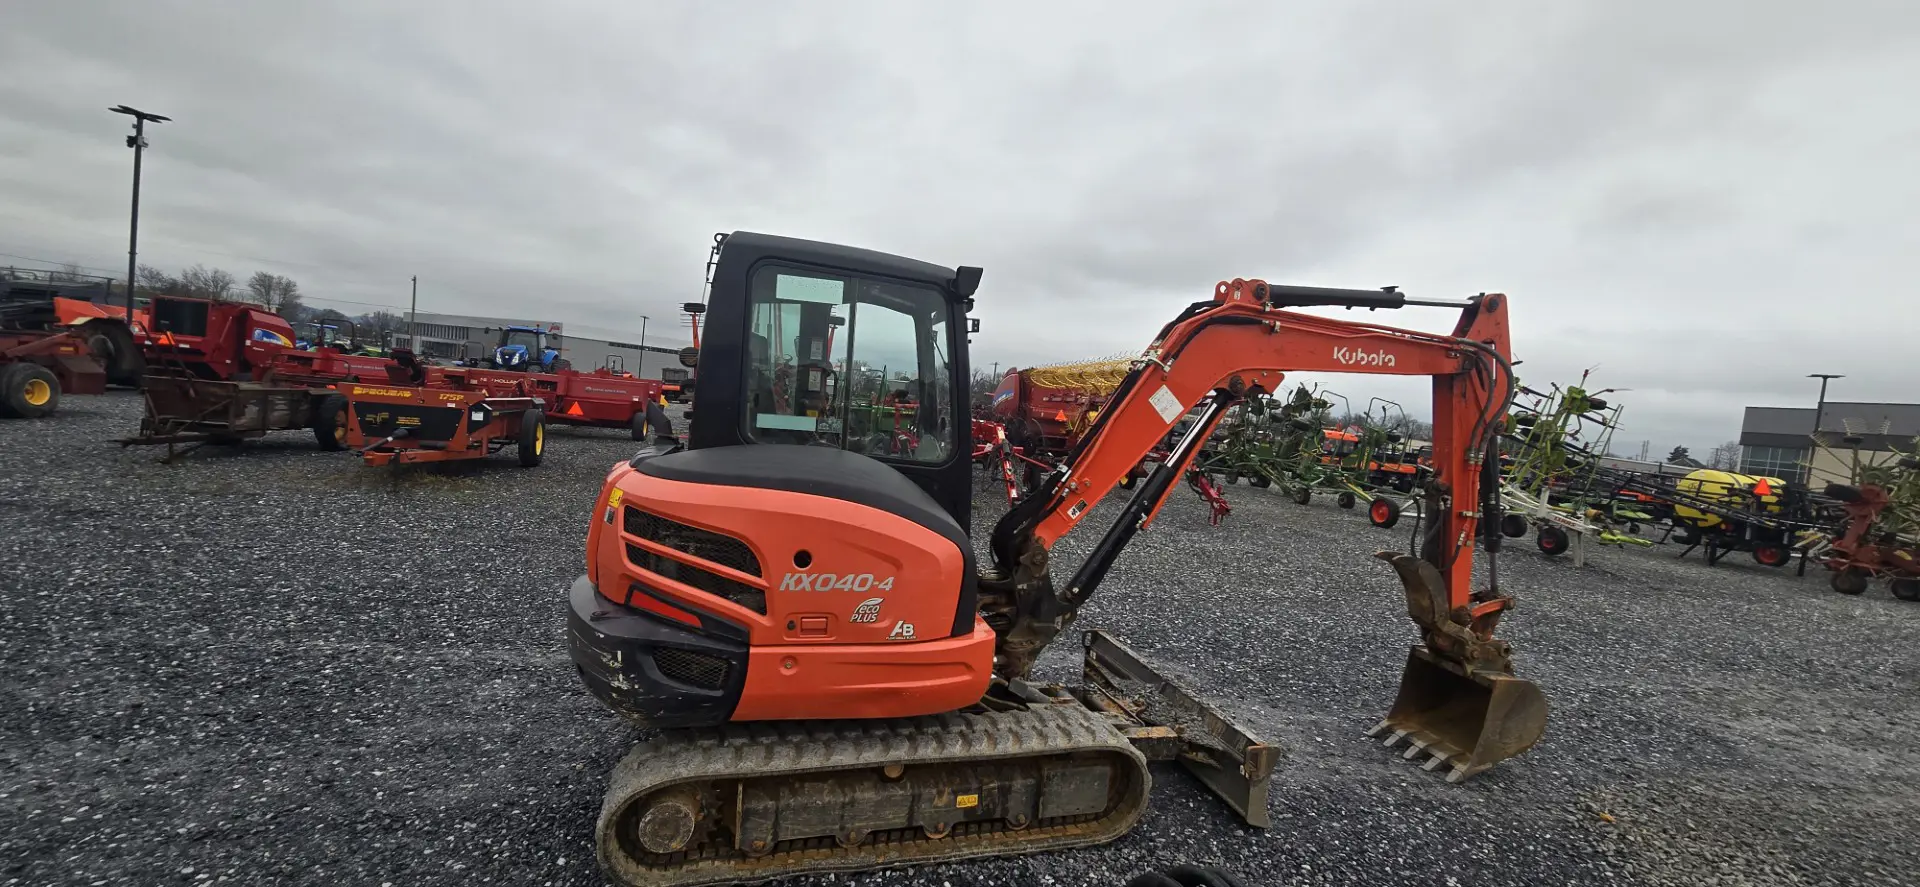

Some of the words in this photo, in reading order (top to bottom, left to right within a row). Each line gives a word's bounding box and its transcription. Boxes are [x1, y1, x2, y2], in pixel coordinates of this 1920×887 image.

[1333, 346, 1395, 367] Kubota
[362, 388, 405, 398] PEQUEA
[779, 572, 895, 592] KX040-4
[859, 604, 880, 614] eco
[849, 613, 878, 623] PLUS
[889, 620, 915, 637] AB
